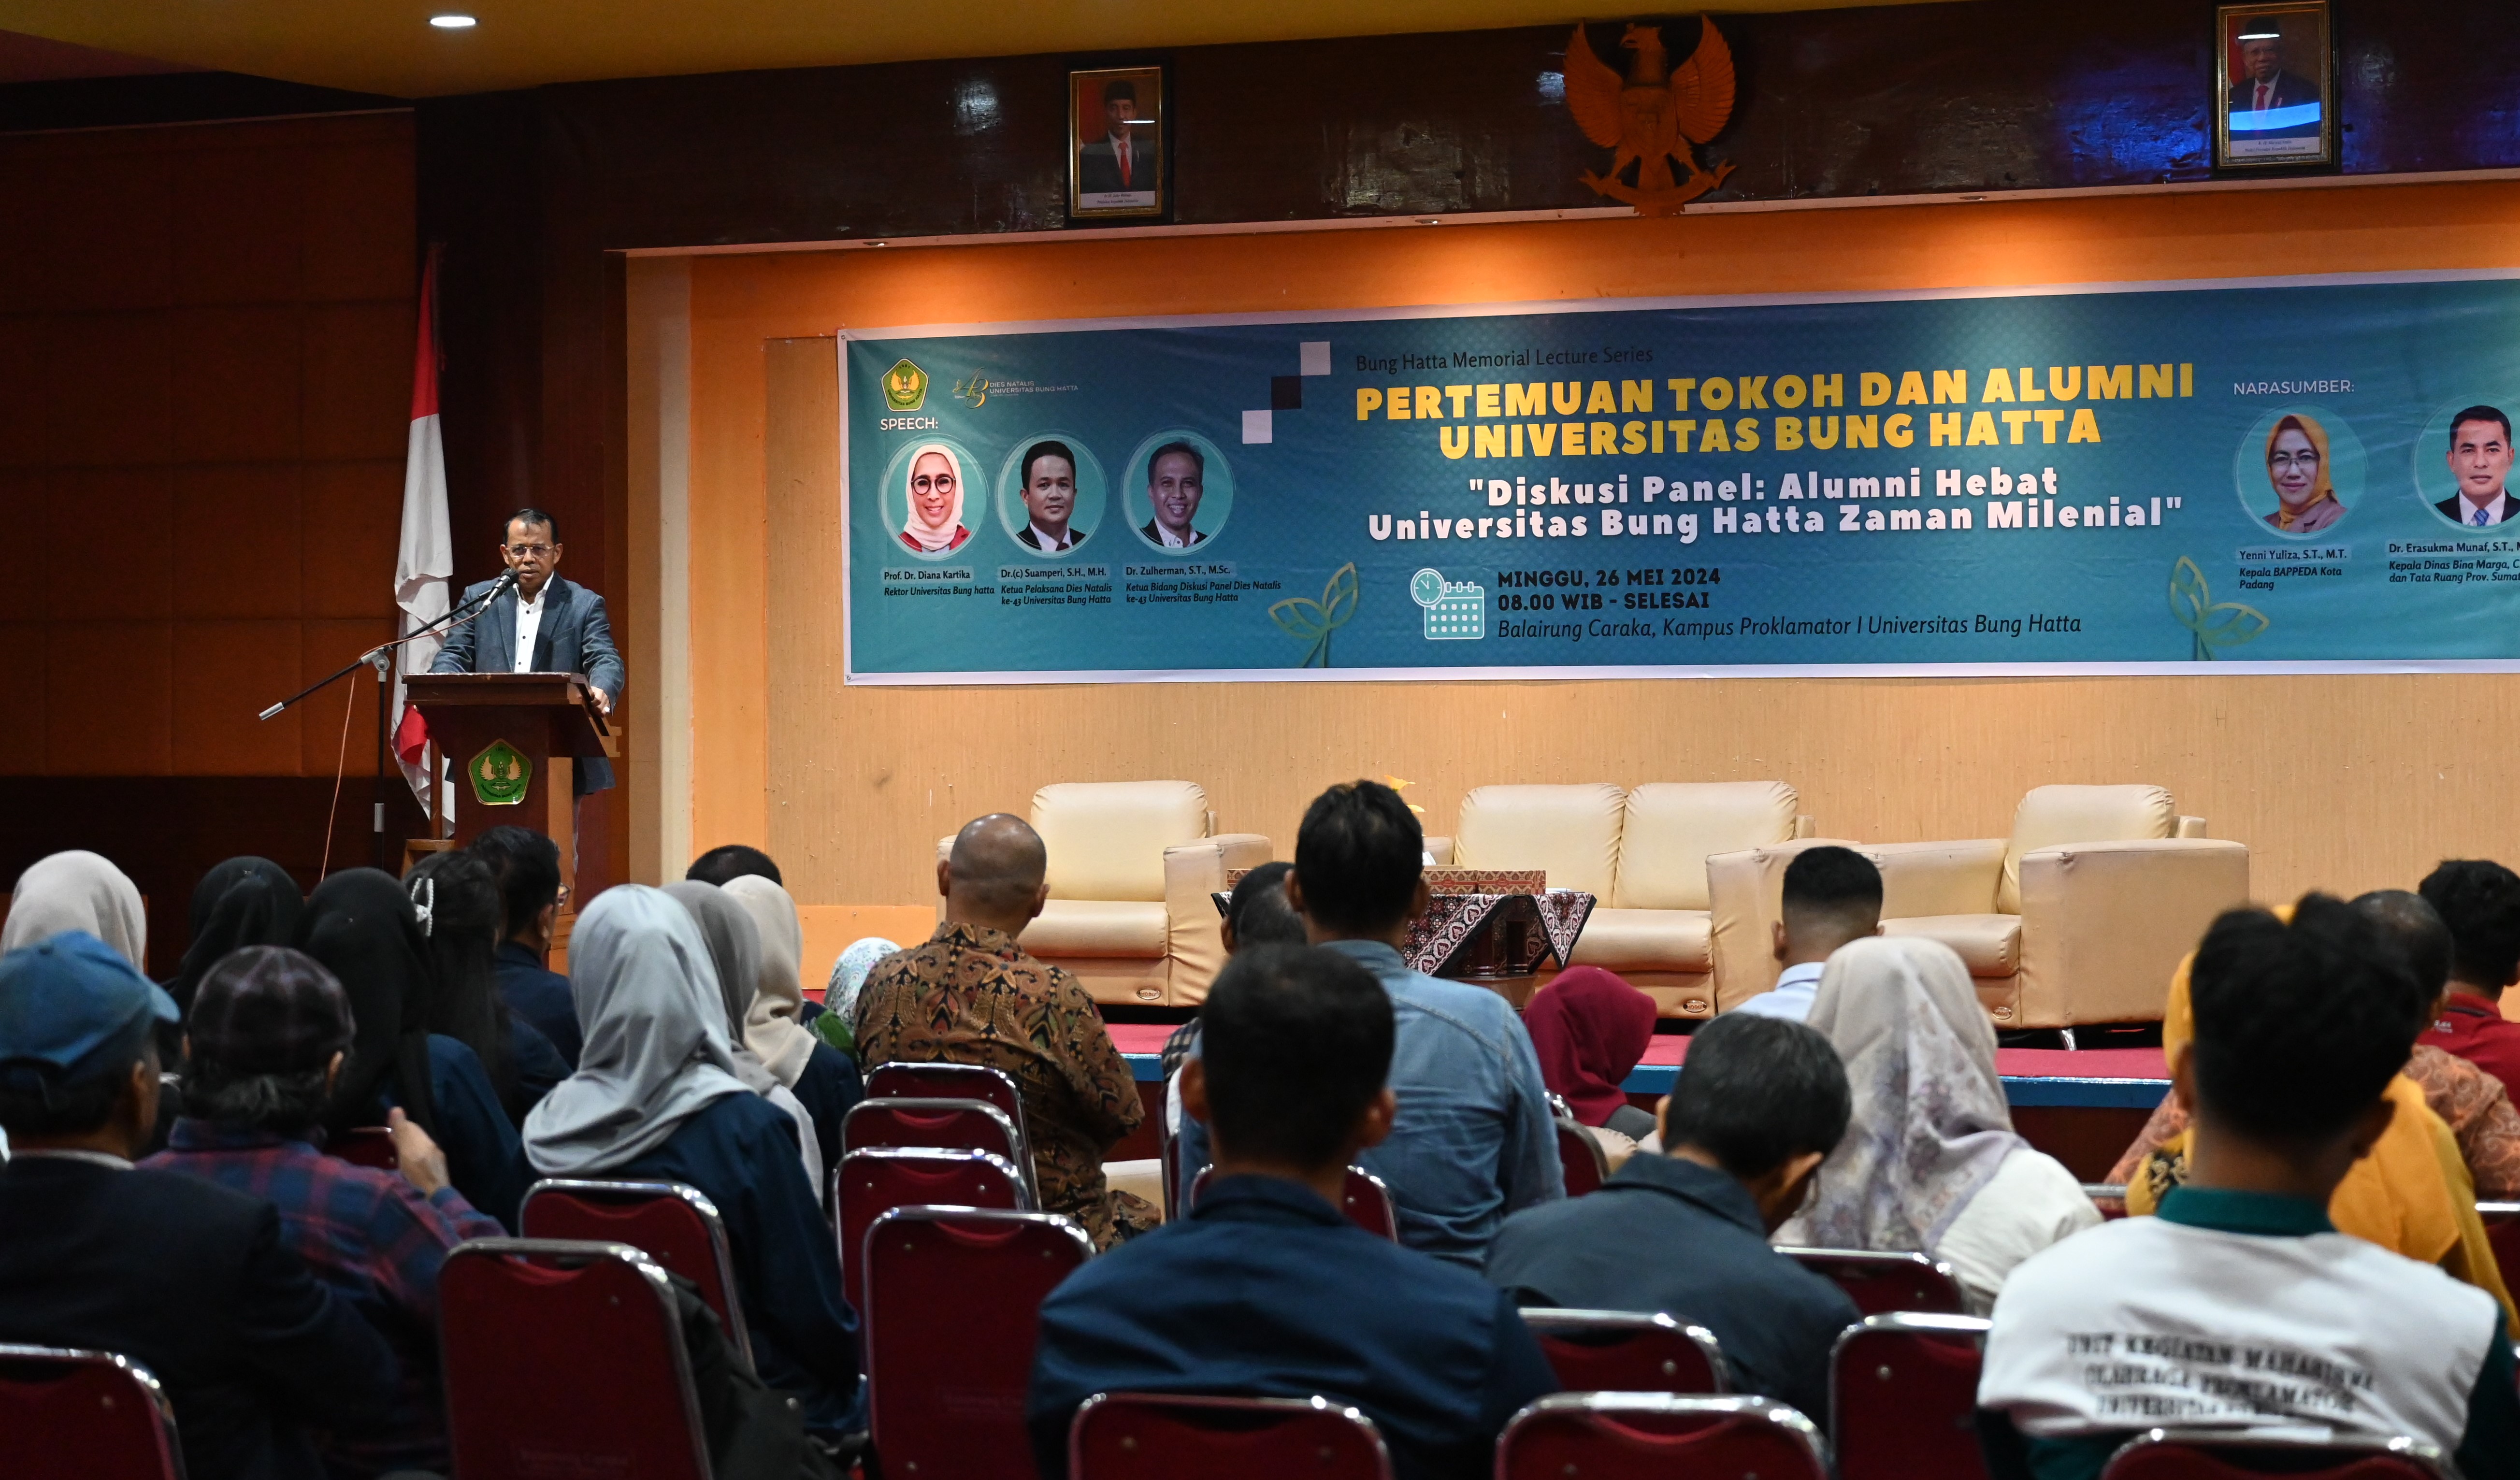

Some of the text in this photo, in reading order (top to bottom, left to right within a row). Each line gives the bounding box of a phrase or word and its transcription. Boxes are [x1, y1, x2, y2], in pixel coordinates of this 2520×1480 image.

[1357, 347, 1653, 374] Bung Hatta Memorial Lecture Series
[1357, 365, 2192, 420] PERTEMUAN TOKOH DAN ALUMNI
[2234, 380, 2354, 394] NARASUMBER:
[880, 417, 938, 430] SPEECH:
[1440, 410, 2101, 458] UNIVERSITAS BUNG HATTA
[1469, 467, 2057, 505] "Diskusi Panel: Alumni Hebat
[1369, 497, 2181, 543] Universitas Bung Hatta Zaman Milenial"
[2389, 544, 2403, 553] Dr.
[2406, 543, 2454, 552] Erasukma
[2457, 542, 2490, 552] Munaf,
[2493, 542, 2513, 552] S.T.,
[2239, 549, 2347, 560] Yenni Yuliza, S.T., M.T.
[1126, 565, 1230, 575] Dr. Zulherman, S.T., M.Sc.
[2389, 560, 2421, 572] Kepala
[2424, 560, 2450, 569] Dinas
[2453, 560, 2474, 569] Bina
[2476, 560, 2509, 571] Marga,
[884, 570, 970, 580] Prof. Dr. Diana Kartika
[1001, 567, 1107, 579] Dr.(c) Suamperi, S.H., M.H.
[1498, 568, 1720, 588] MINGGU, 26 MEI 2024
[2239, 567, 2342, 579] Kepala BAPPEDA Kota
[2389, 573, 2407, 582] dan
[2409, 573, 2431, 582] Tata
[2434, 573, 2463, 584] Ruang
[2466, 572, 2489, 581] Prov.
[1001, 583, 1112, 594] Ketua Pelaksana Dies Natalis
[1126, 580, 1281, 593] Ketua Bidang Diskusi Panel Dies Natalis
[2239, 579, 2274, 590] Padang
[884, 586, 995, 596] Rektor Universitas Bung hatta
[1001, 595, 1111, 606] ke-43 Universitas Bung Hatta
[1126, 593, 1238, 604] ke-43 Universitas Bung Hatta
[1498, 594, 1554, 611] 08.00
[1561, 593, 1603, 610] WIB
[1624, 592, 1709, 609] SELESAI
[1498, 620, 1582, 642] Balairung
[1589, 618, 1656, 637] Caraka,
[1663, 618, 1733, 640] Kampus
[1740, 617, 1851, 634] Proklamator
[1869, 616, 1968, 633] Universitas
[1975, 615, 2021, 637] Bung
[2029, 614, 2081, 632] Hatta
